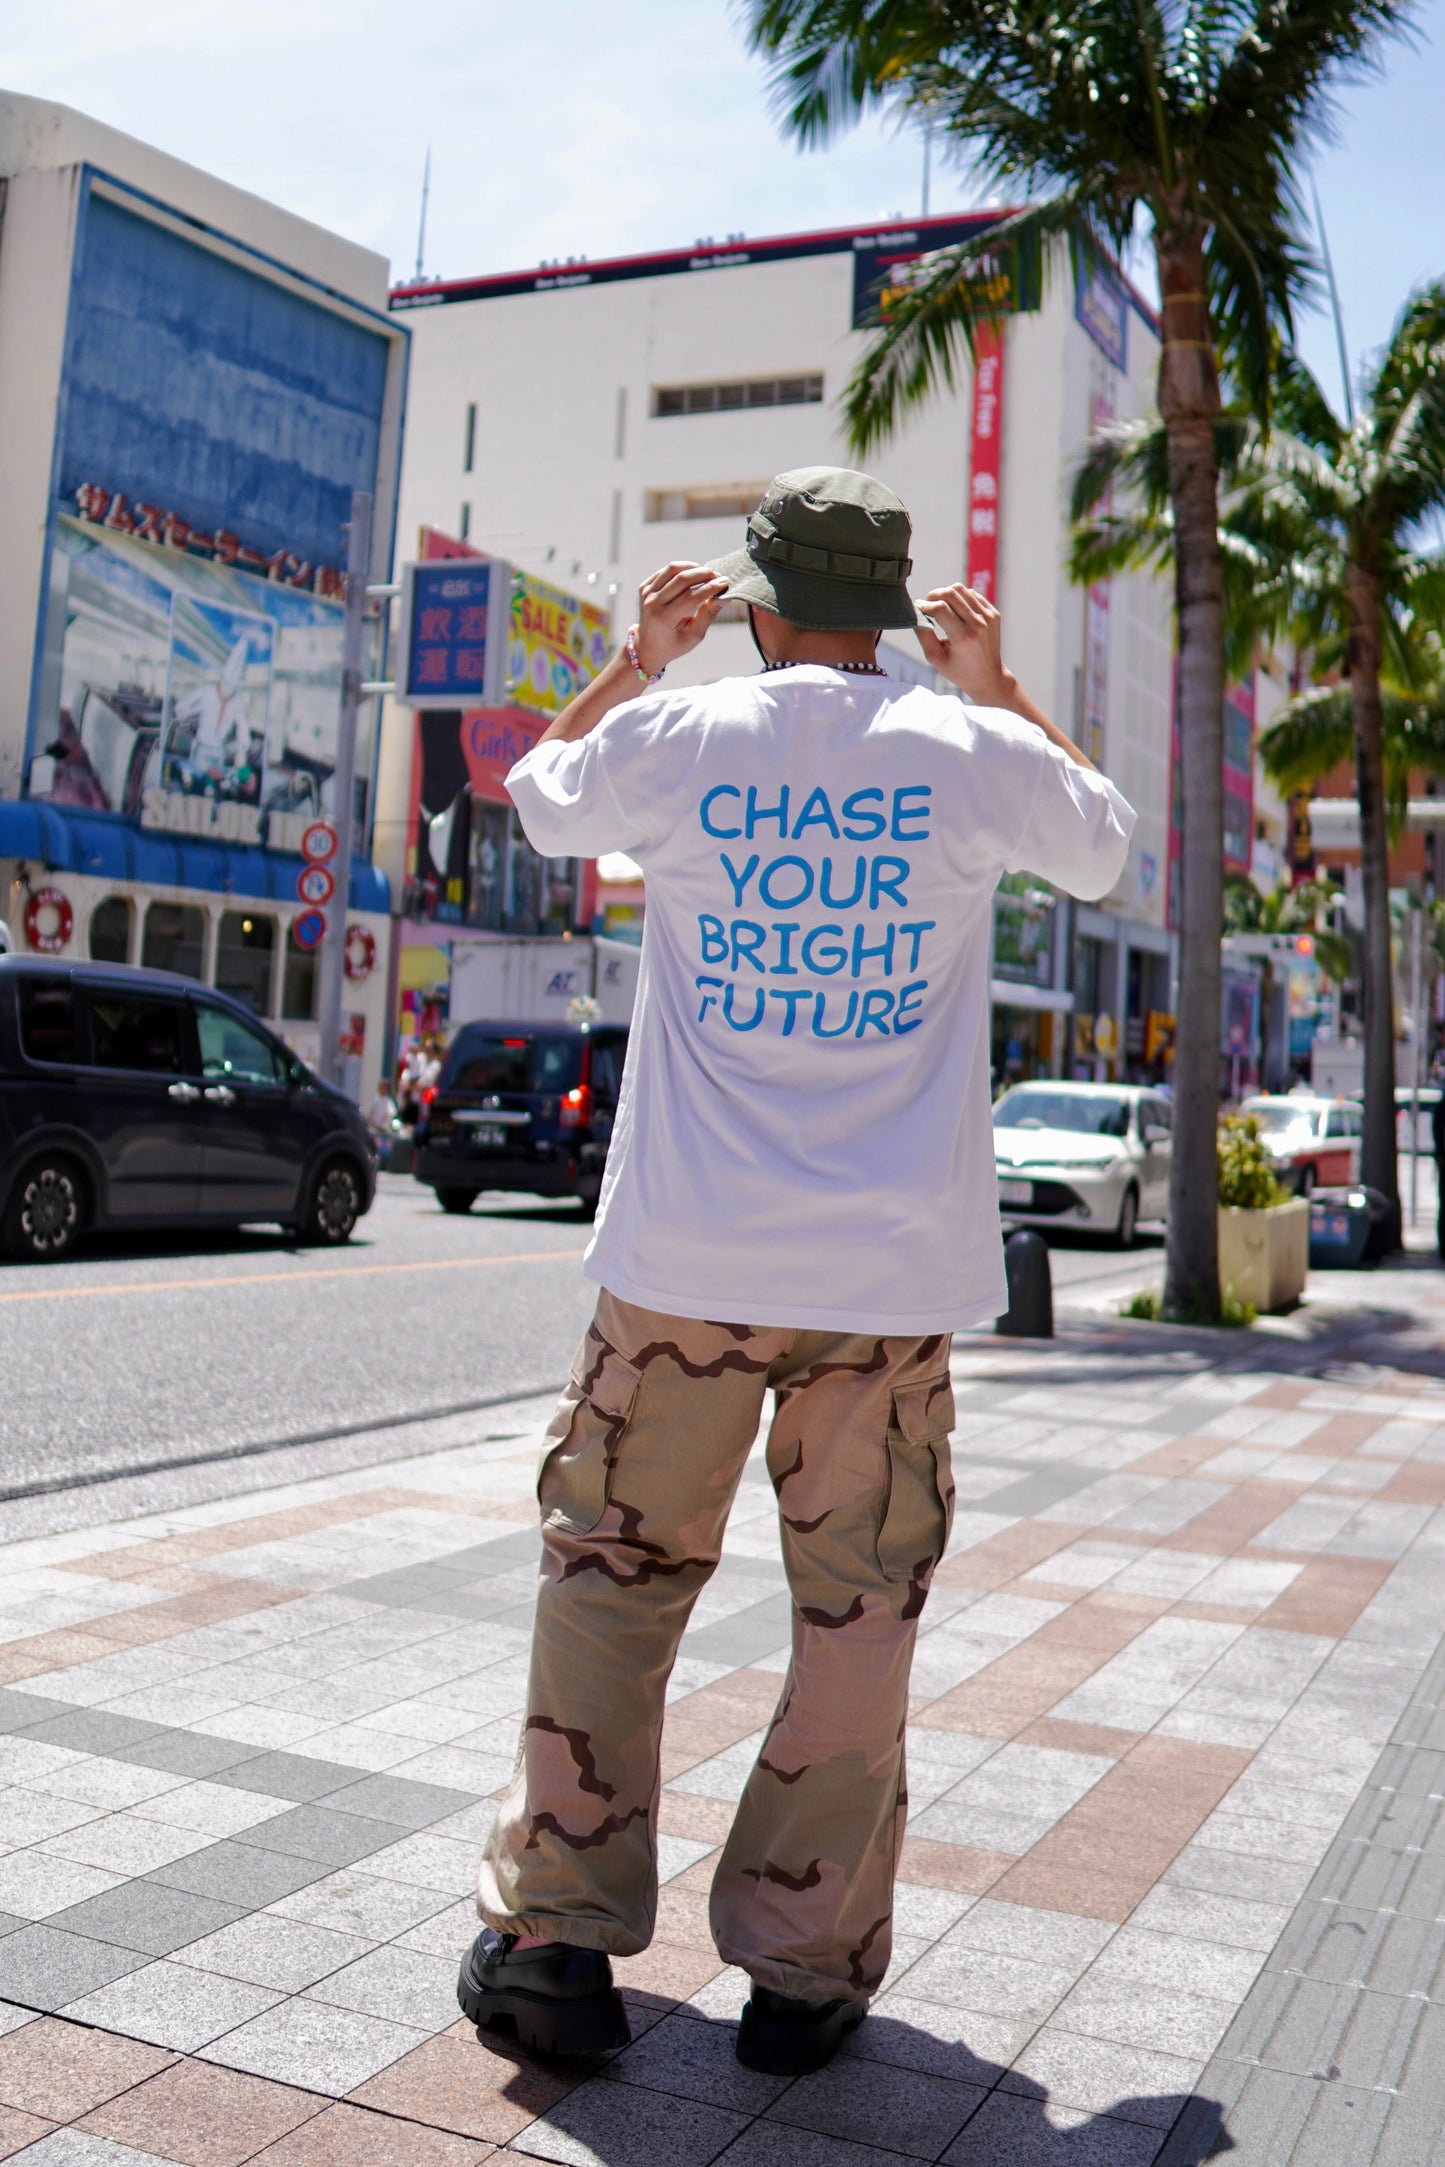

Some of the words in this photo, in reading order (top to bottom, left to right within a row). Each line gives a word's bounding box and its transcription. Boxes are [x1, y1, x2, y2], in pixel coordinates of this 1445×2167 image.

[521, 597, 568, 646] SALE
[140, 788, 262, 845] SAILOR
[267, 810, 318, 852] IN
[700, 784, 932, 841] CHASE
[311, 834, 330, 850] 30
[720, 853, 910, 910] YOUR
[698, 914, 936, 978] BRIGHT
[695, 975, 928, 1038] FUTURE
